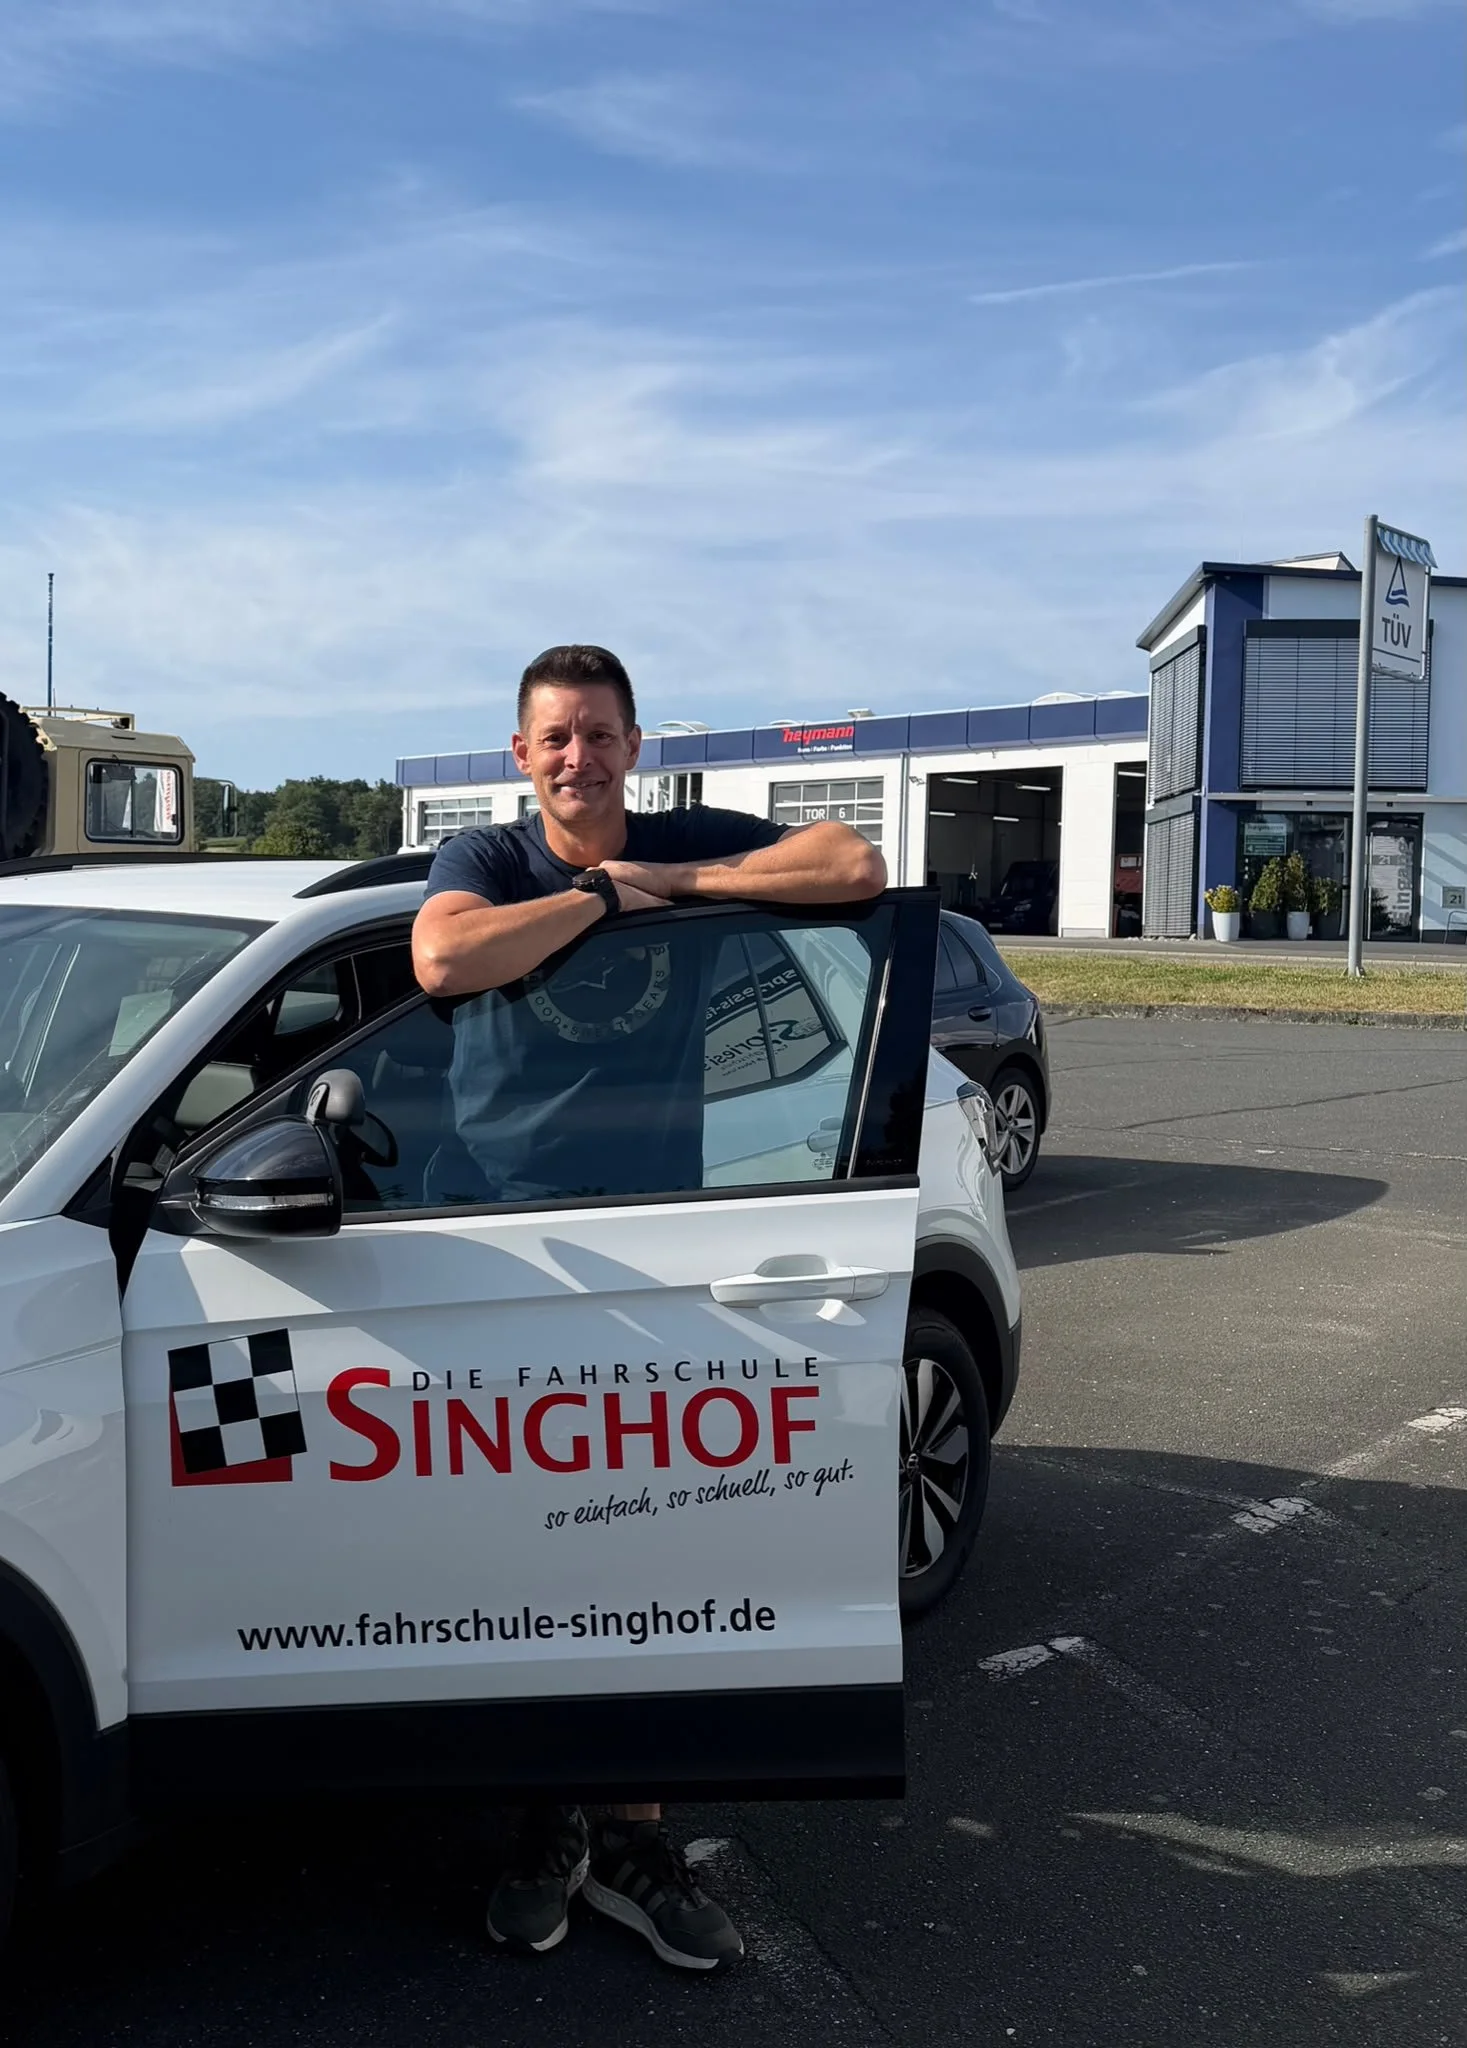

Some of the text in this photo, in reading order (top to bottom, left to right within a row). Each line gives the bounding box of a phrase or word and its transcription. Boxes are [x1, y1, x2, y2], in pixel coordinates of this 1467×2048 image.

[1381, 612, 1412, 649] TÜV
[782, 725, 855, 745] heymann
[804, 806, 846, 820] TOR 6
[1379, 855, 1391, 865] 21
[1449, 893, 1463, 905] 21
[412, 1356, 820, 1392] DIE FAHRSCHULE
[326, 1366, 819, 1482] SINGHOF
[544, 1457, 855, 1530] so einfach, so schnell, so gut.
[236, 1597, 777, 1651] www.fahrschule-singhof.de
